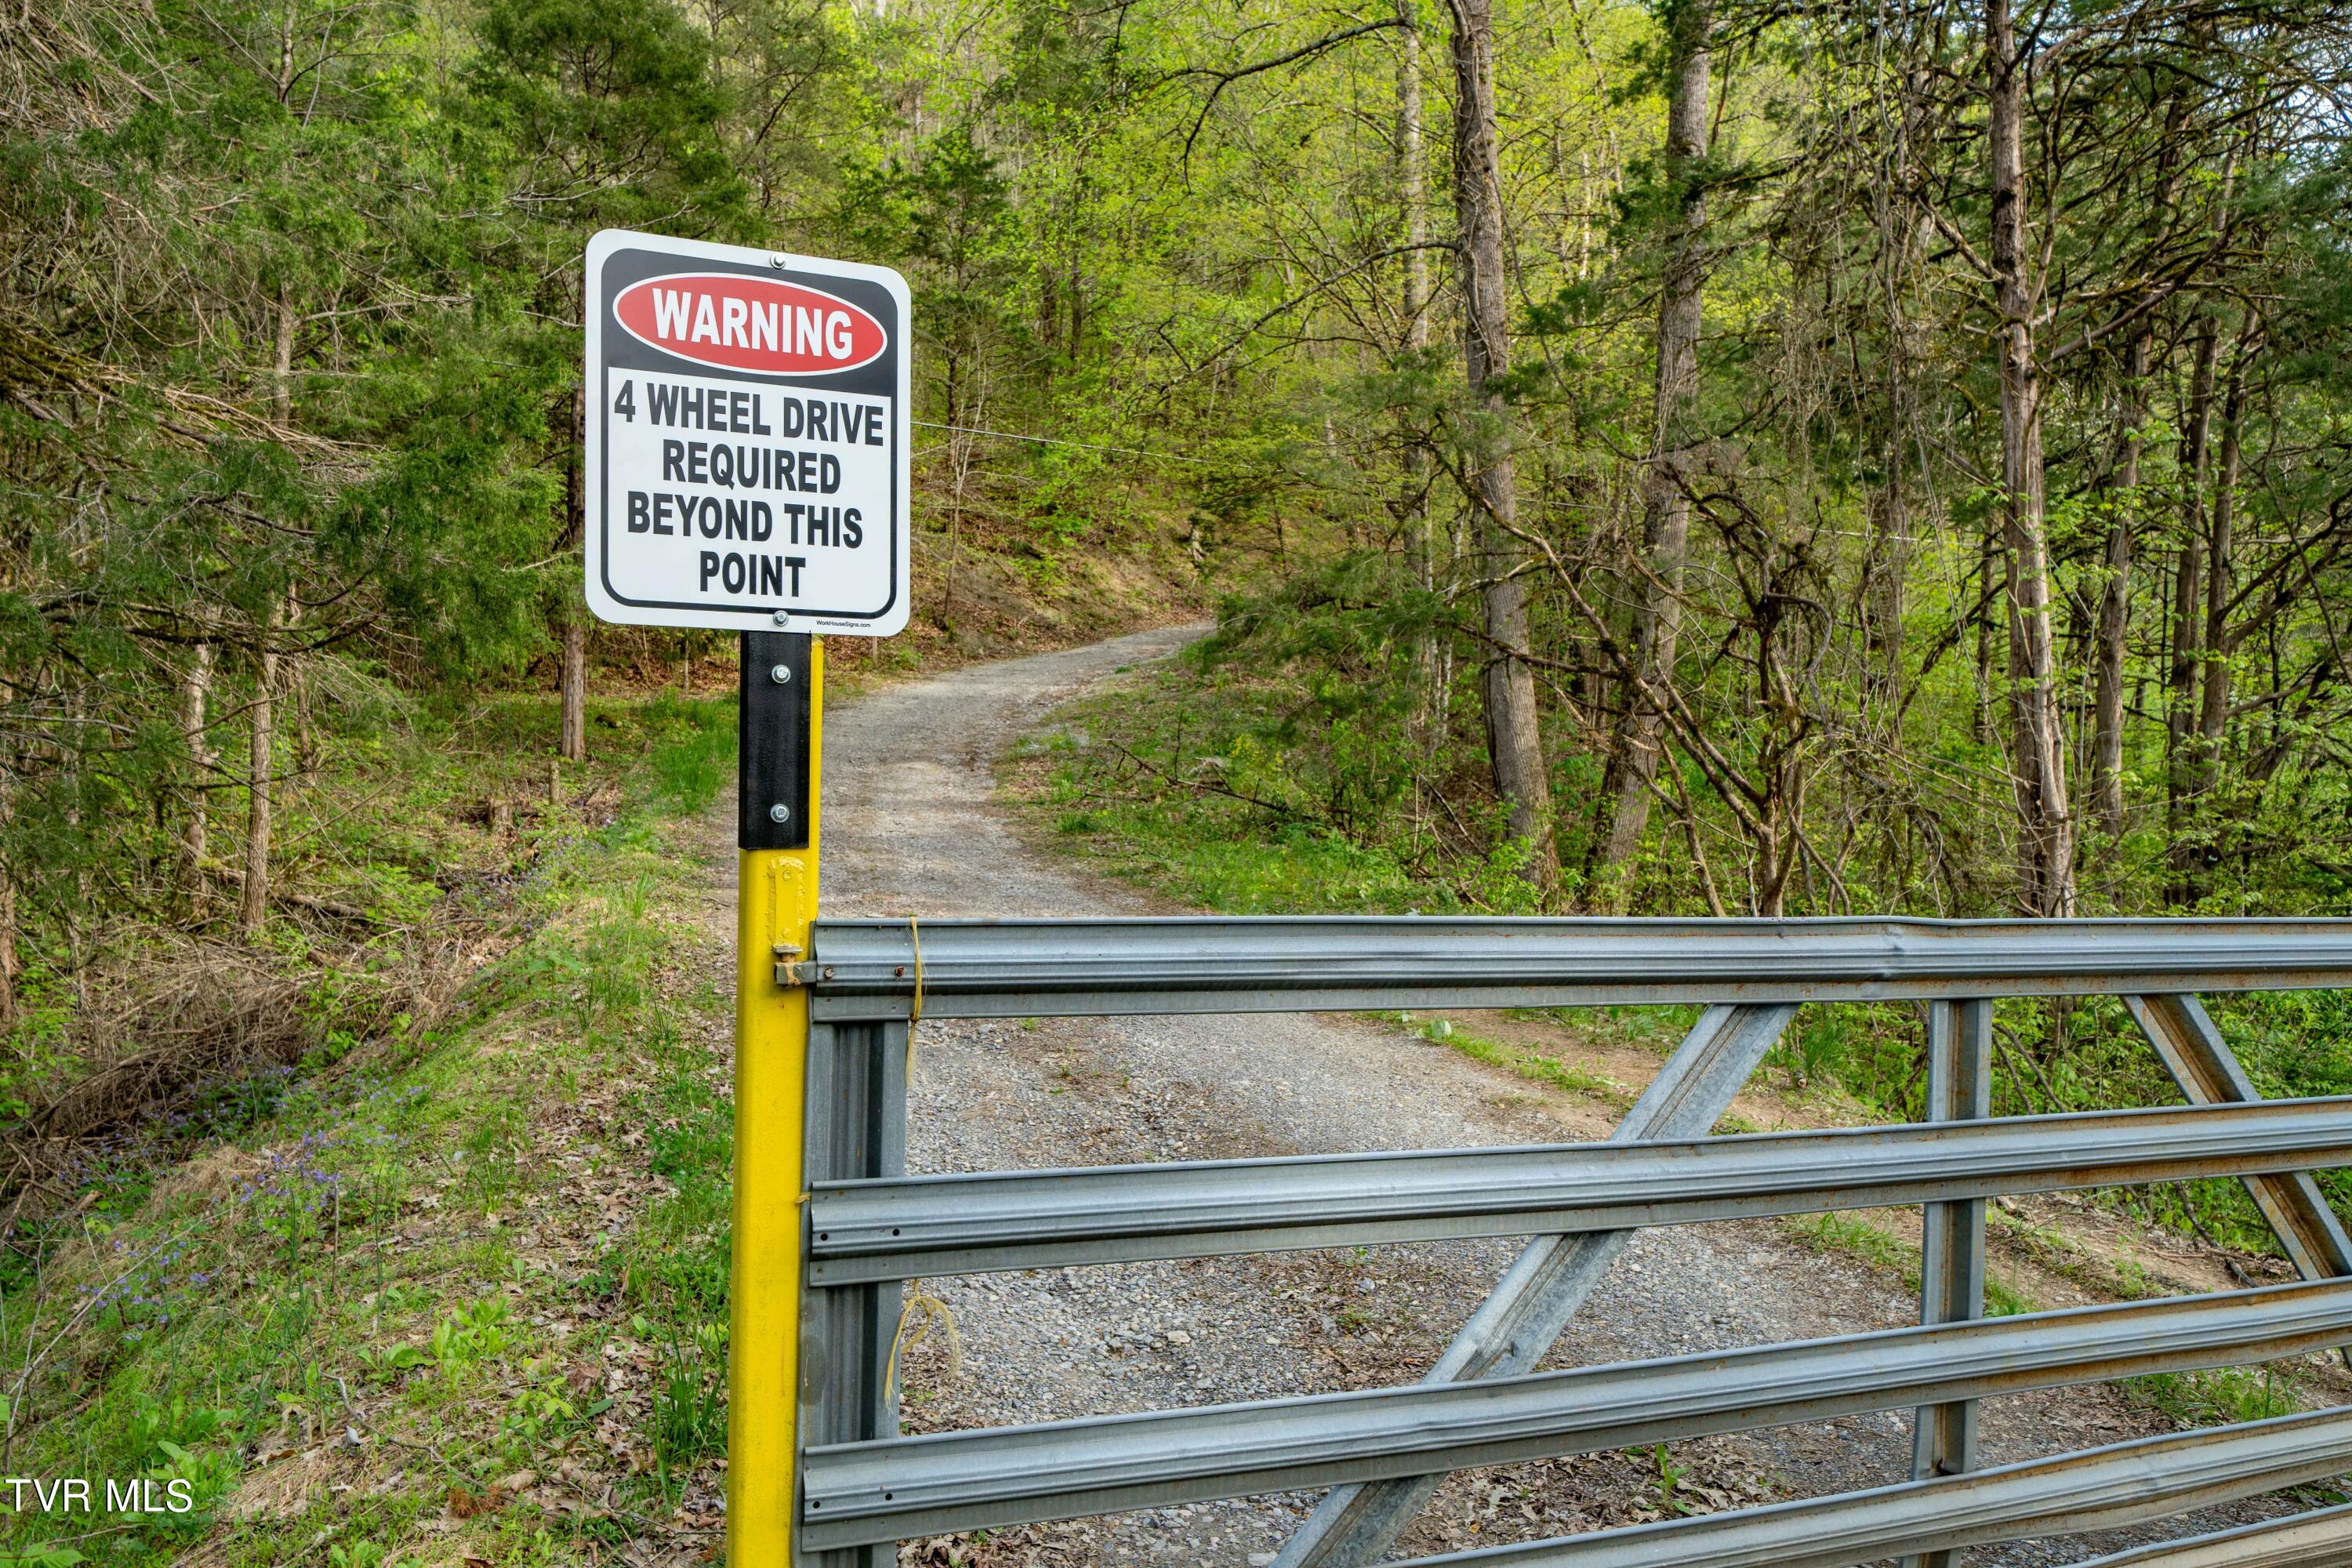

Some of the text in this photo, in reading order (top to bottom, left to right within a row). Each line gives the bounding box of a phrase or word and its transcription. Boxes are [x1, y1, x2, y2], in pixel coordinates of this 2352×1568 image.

[652, 288, 853, 360] WARNING
[614, 379, 884, 446] 4 WHEEL DRIVE
[662, 439, 841, 495] REQUIRED
[627, 491, 863, 549] BEYOND THIS
[699, 550, 806, 597] POINT
